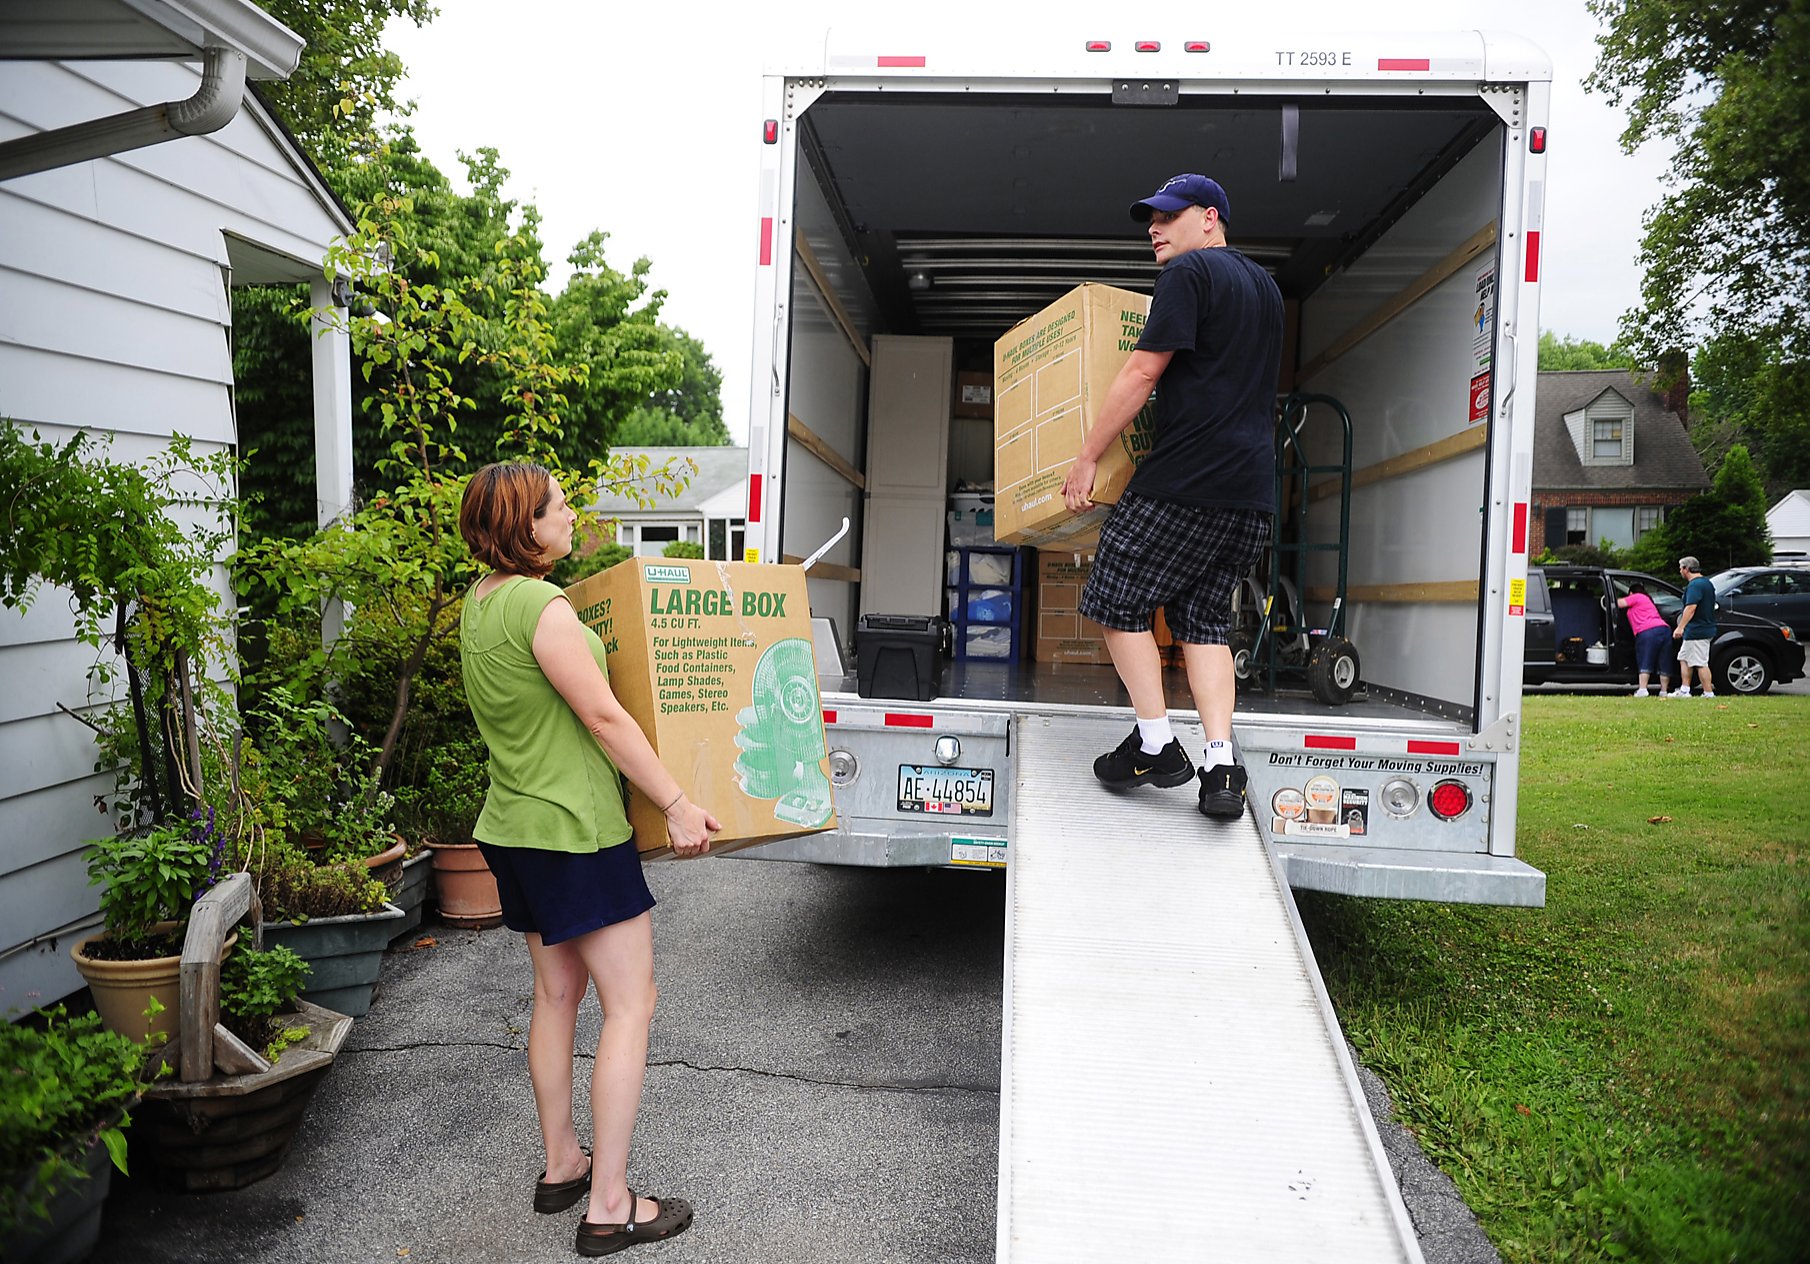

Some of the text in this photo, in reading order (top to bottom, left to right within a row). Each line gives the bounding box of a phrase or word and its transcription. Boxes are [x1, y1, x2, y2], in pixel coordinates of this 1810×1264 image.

[1275, 51, 1352, 66] TT 2593 E
[1036, 326, 1047, 339] ARE
[1047, 310, 1076, 333] DESIGNED
[1021, 338, 1045, 358] MULTIPLE
[1046, 327, 1064, 343] USES!
[1021, 493, 1053, 512] uhaul.com
[647, 567, 688, 577] U-HAUL
[650, 588, 787, 618] LARGE BOX
[650, 617, 701, 629] 4.5 CU FT.
[653, 636, 669, 648] For
[672, 636, 728, 649] Lightweight
[654, 649, 728, 660] Such as Plastic
[656, 662, 736, 674] Food Containers,
[657, 675, 724, 688] Lamp Shades,
[659, 688, 728, 701] Games, Stereo
[660, 701, 729, 715] Speakers, Etc.
[1268, 752, 1484, 775] Don't Forget Your Moving Supplies!
